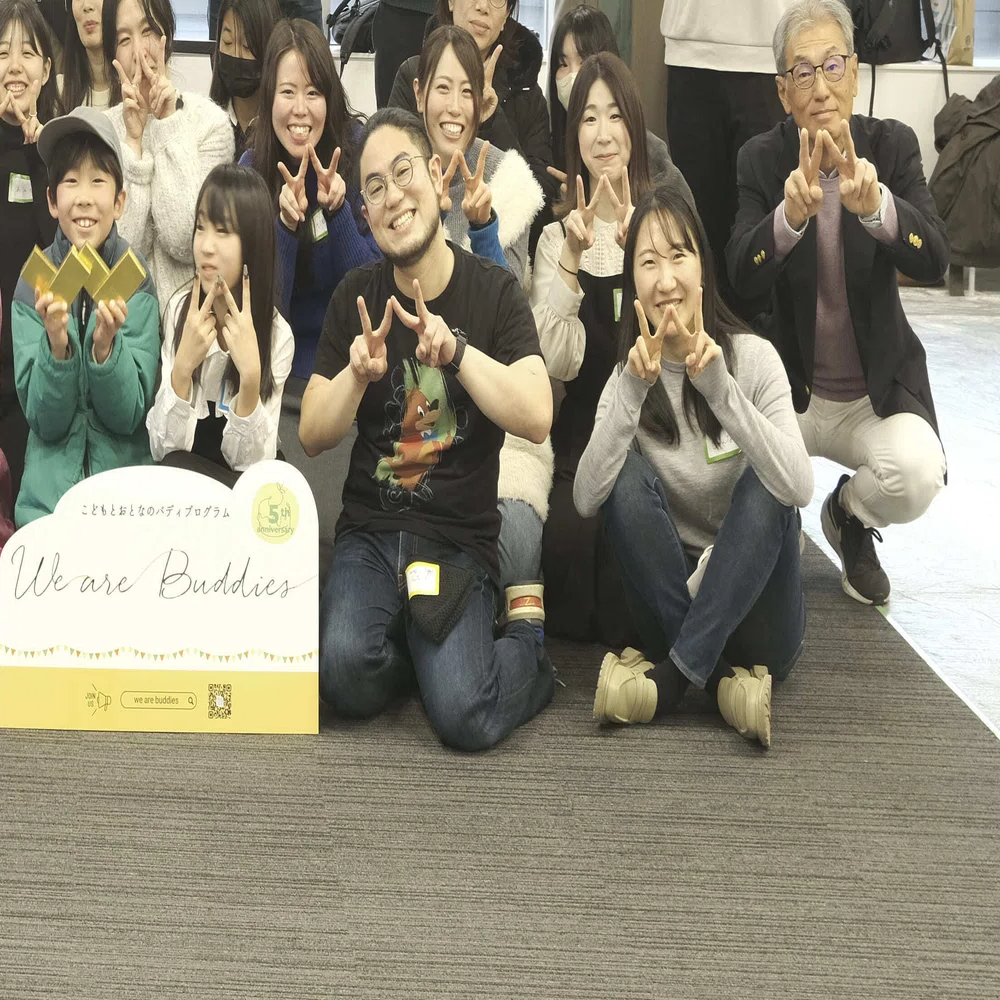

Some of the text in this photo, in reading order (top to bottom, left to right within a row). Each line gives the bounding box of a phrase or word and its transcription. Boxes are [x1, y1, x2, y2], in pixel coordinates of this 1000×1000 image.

[256, 525, 295, 536] anniversary
[11, 545, 317, 600] We are Buddies
[85, 692, 96, 700] JOIN
[144, 696, 155, 704] are
[155, 695, 179, 704] buddies
